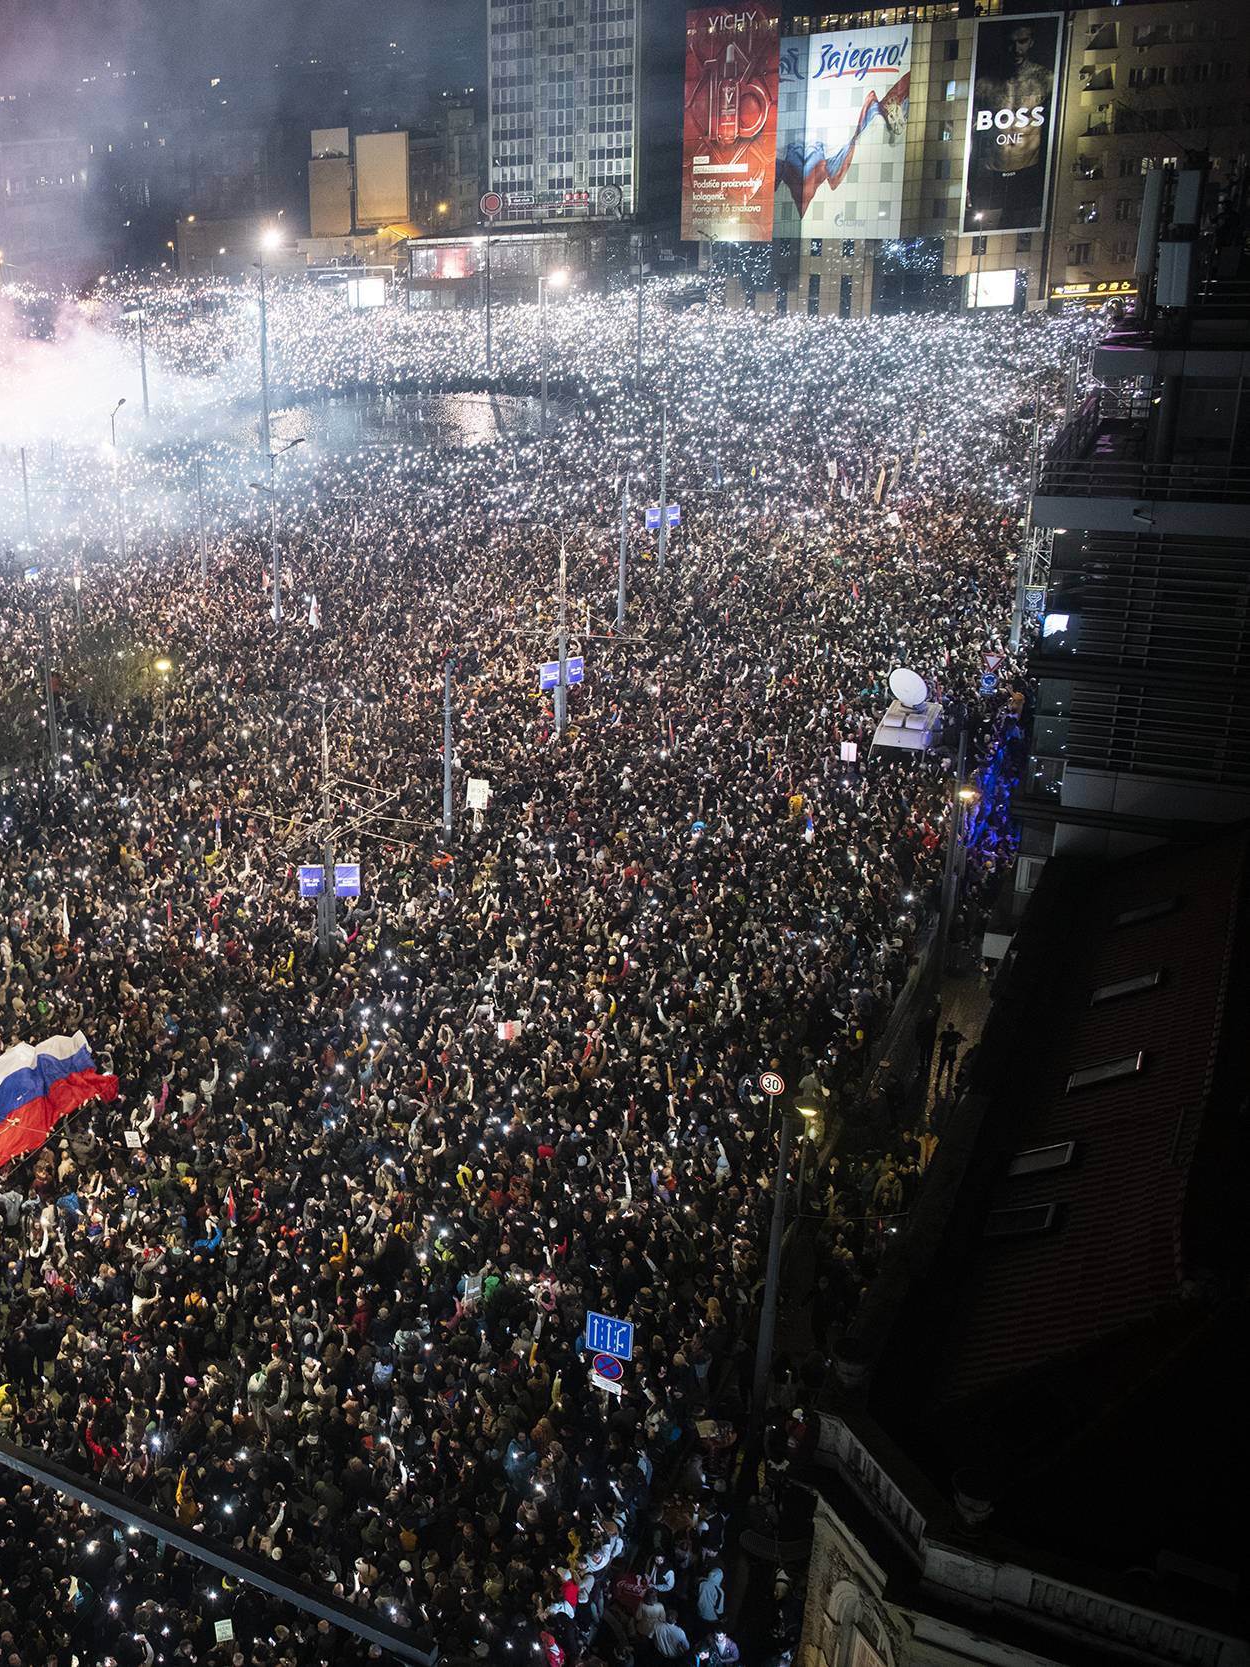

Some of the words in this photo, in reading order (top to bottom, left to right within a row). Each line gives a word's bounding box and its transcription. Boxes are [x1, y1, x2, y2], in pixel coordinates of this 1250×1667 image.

[708, 11, 757, 30] VICHY
[976, 106, 1045, 131] BOSS
[996, 133, 1024, 146] ONE
[693, 179, 719, 188] Podstiče
[692, 203, 720, 215] Koriguje
[722, 203, 731, 212] 16
[731, 204, 762, 213] znakova
[764, 1077, 779, 1090] 30
